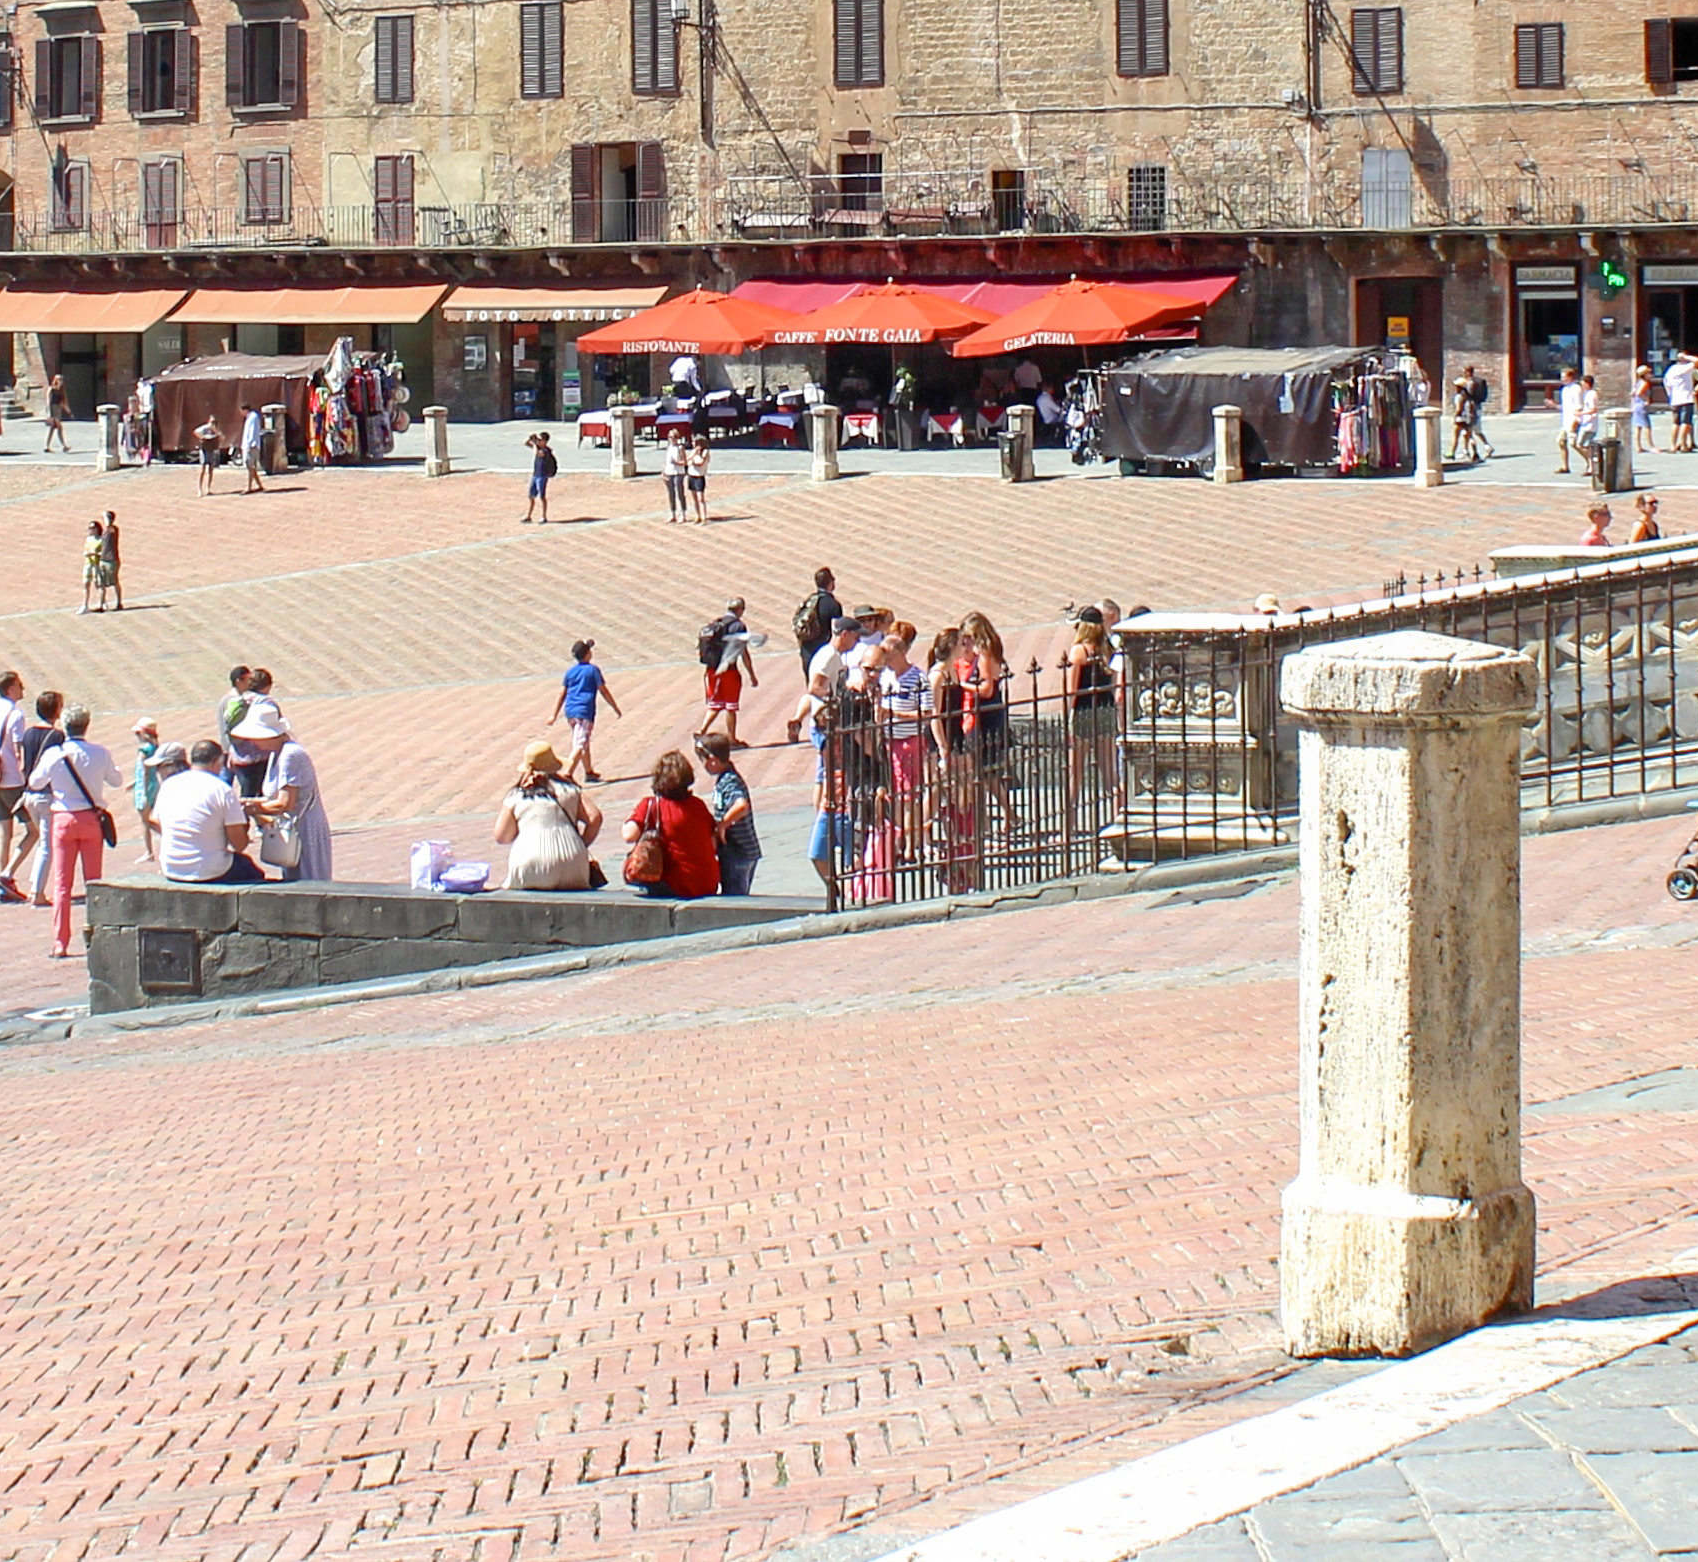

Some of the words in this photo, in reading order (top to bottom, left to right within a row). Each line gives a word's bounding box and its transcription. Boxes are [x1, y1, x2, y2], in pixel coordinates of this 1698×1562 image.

[1518, 268, 1574, 281] FARMACIA
[466, 310, 519, 322] FOTO
[552, 309, 637, 322] OTTICA
[824, 328, 879, 343] FONTE
[883, 328, 922, 343] GAIA
[1004, 331, 1075, 351] GELATERIA
[622, 340, 700, 354] RISTORANTE
